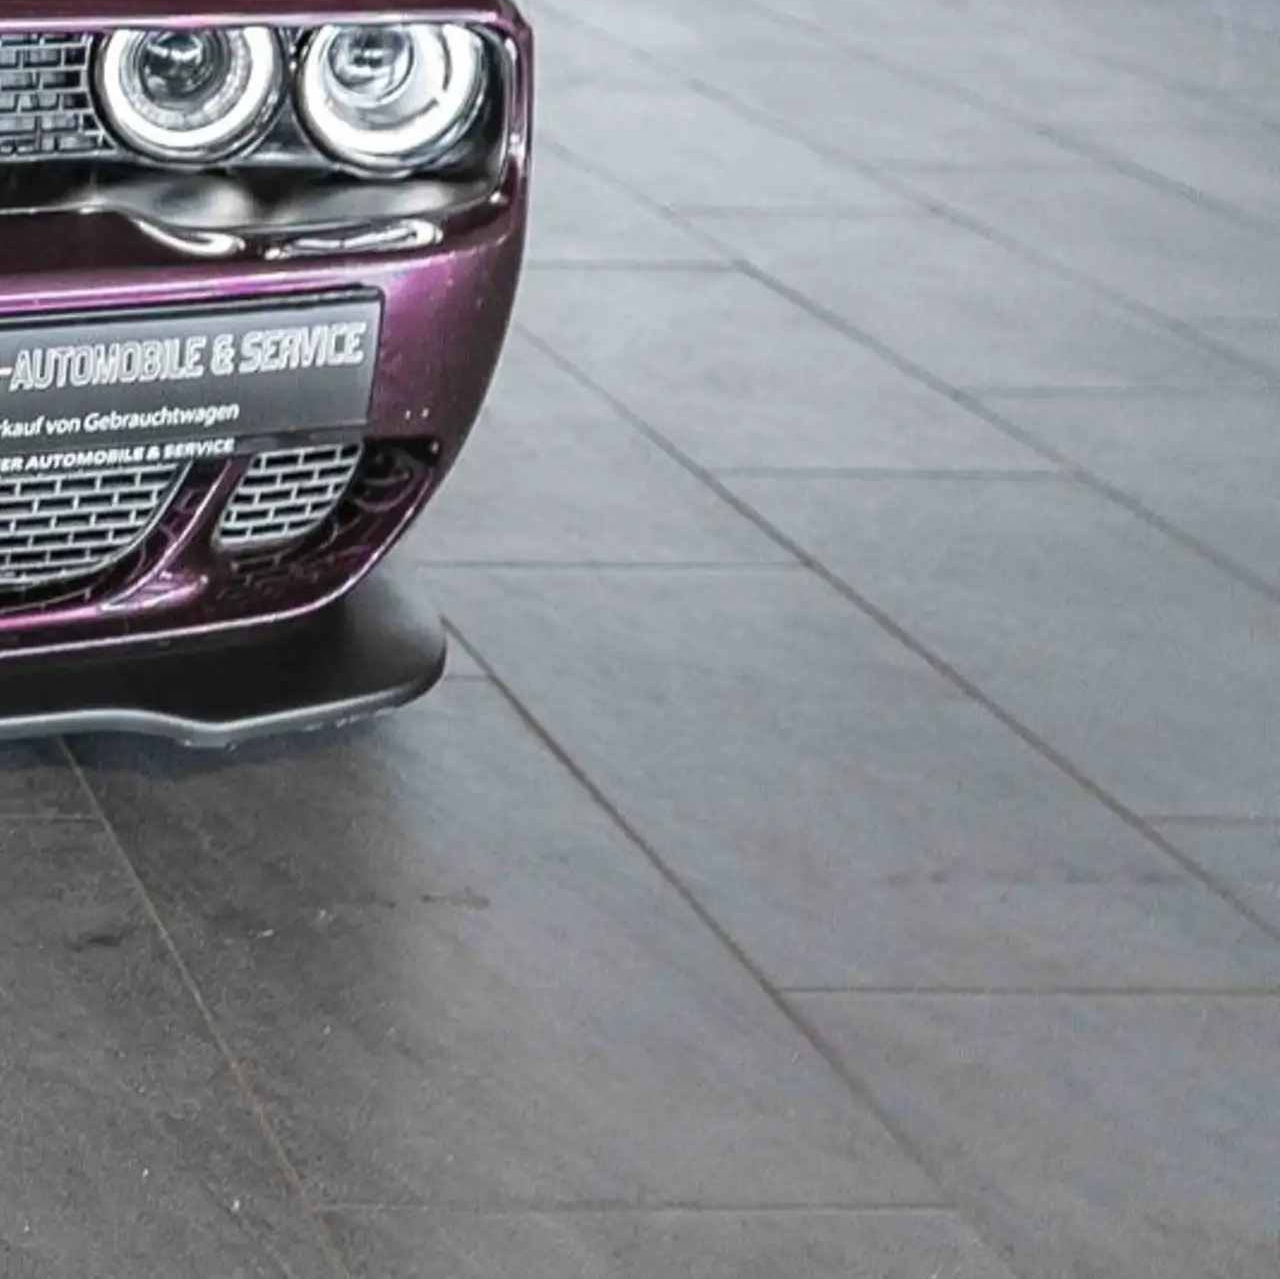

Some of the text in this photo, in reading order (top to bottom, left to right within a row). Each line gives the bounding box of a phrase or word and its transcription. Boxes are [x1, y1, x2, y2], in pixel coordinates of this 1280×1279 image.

[211, 333, 235, 377] &
[239, 320, 367, 373] SERVICE
[45, 417, 81, 434] von
[83, 403, 240, 433] Gebrauchtwagen
[25, 446, 144, 472] AUTOMOBILE
[146, 443, 161, 462] &
[163, 437, 236, 460] SERVICE
